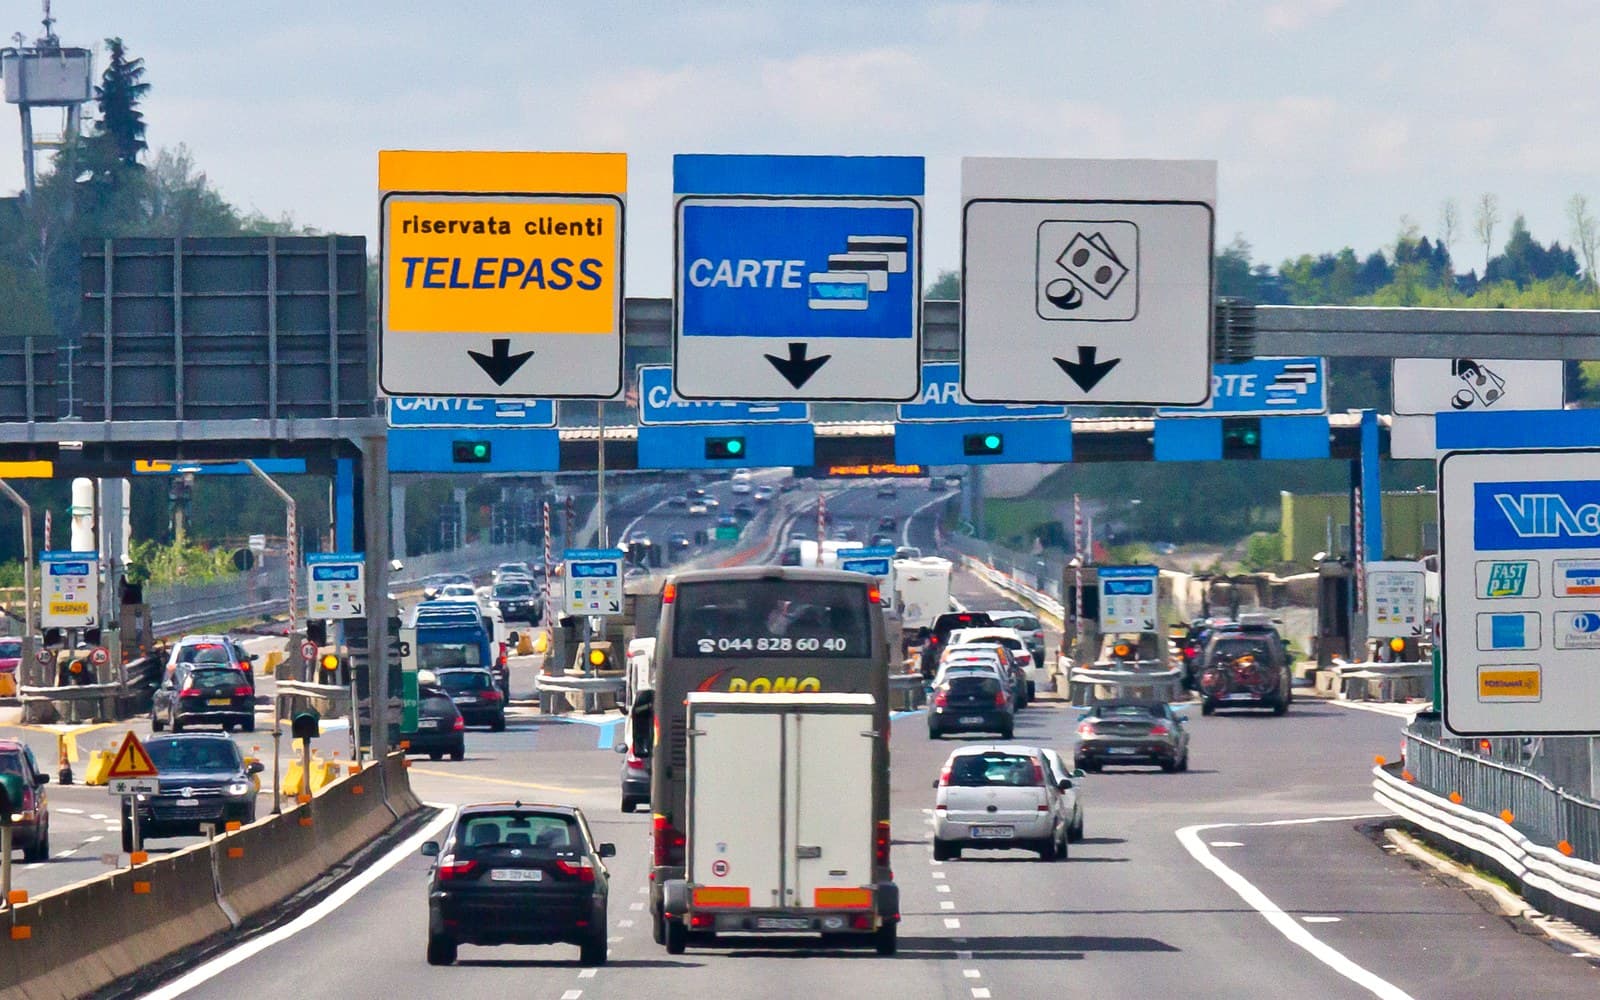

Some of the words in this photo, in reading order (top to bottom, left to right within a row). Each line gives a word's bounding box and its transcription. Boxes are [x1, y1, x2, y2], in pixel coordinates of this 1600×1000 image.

[402, 216, 511, 235] riservata
[524, 217, 603, 236] clienti
[401, 257, 603, 290] TELEPASS
[688, 258, 806, 289] CARTE
[1493, 565, 1525, 579] FAST
[718, 638, 752, 651] 044
[756, 638, 792, 651] 828
[796, 638, 819, 651] 60
[823, 638, 846, 651] 40
